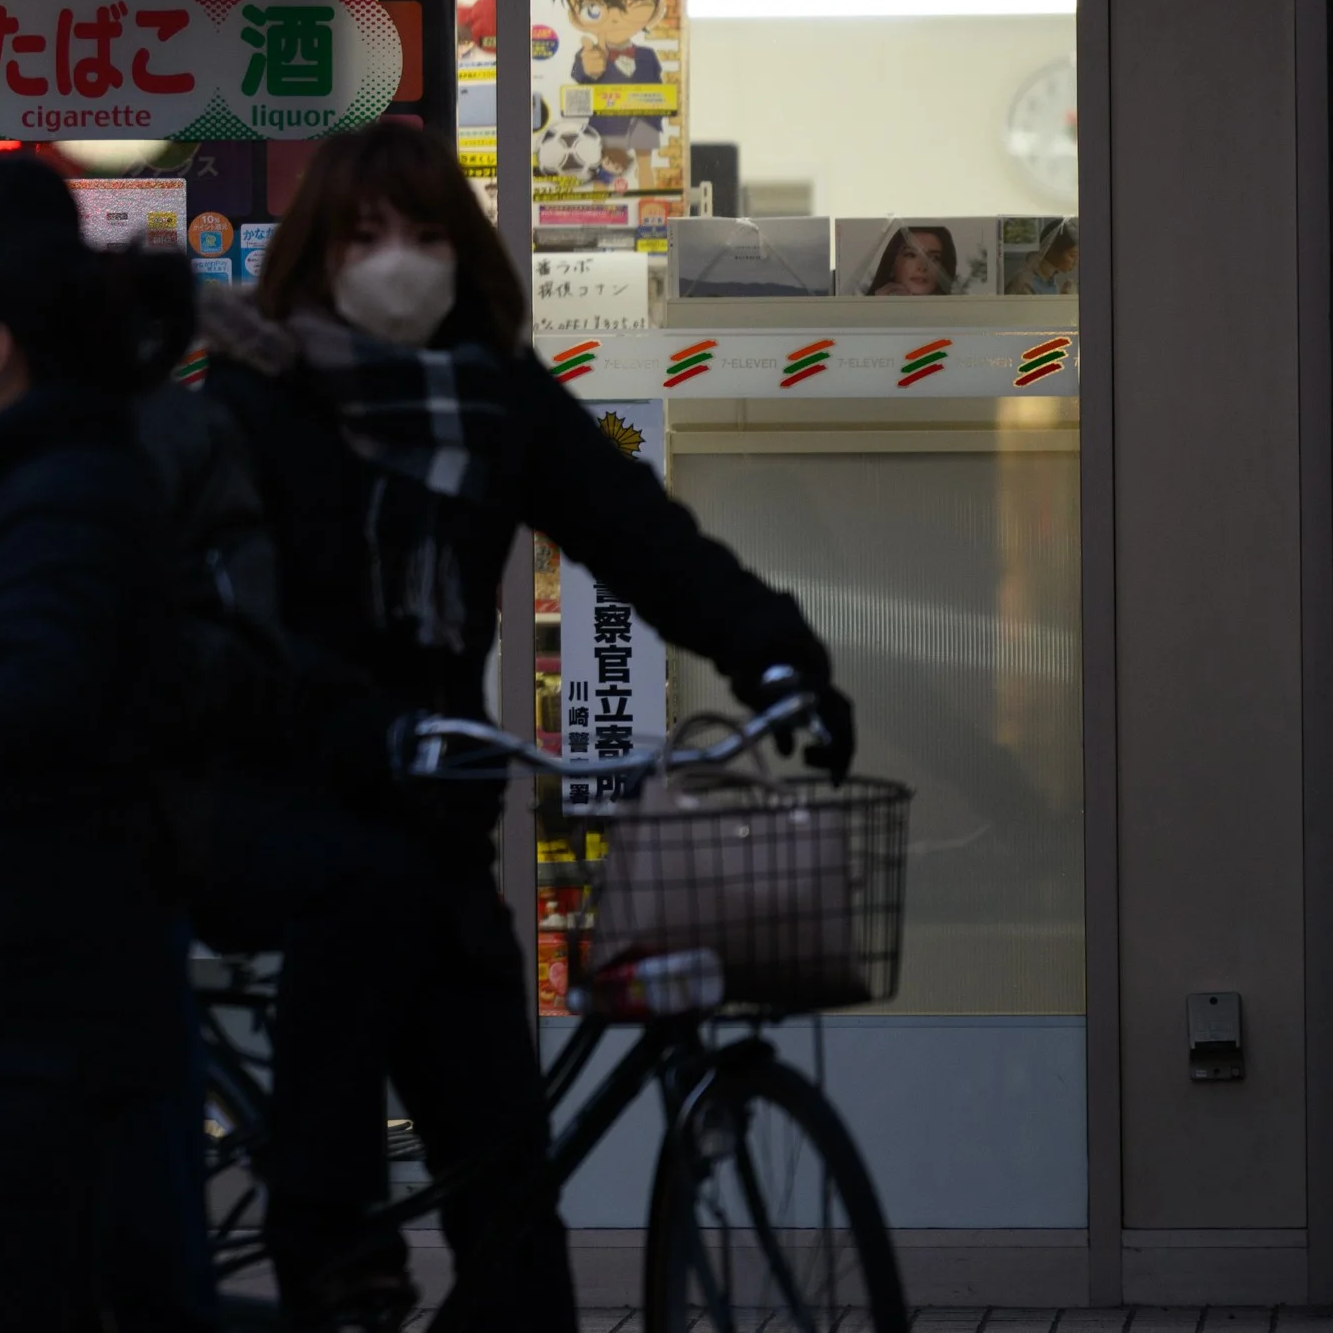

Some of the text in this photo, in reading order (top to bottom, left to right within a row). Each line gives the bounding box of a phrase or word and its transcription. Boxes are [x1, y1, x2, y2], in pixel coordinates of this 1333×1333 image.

[240, 4, 335, 97] 酒
[22, 105, 335, 132] cigarette liquor
